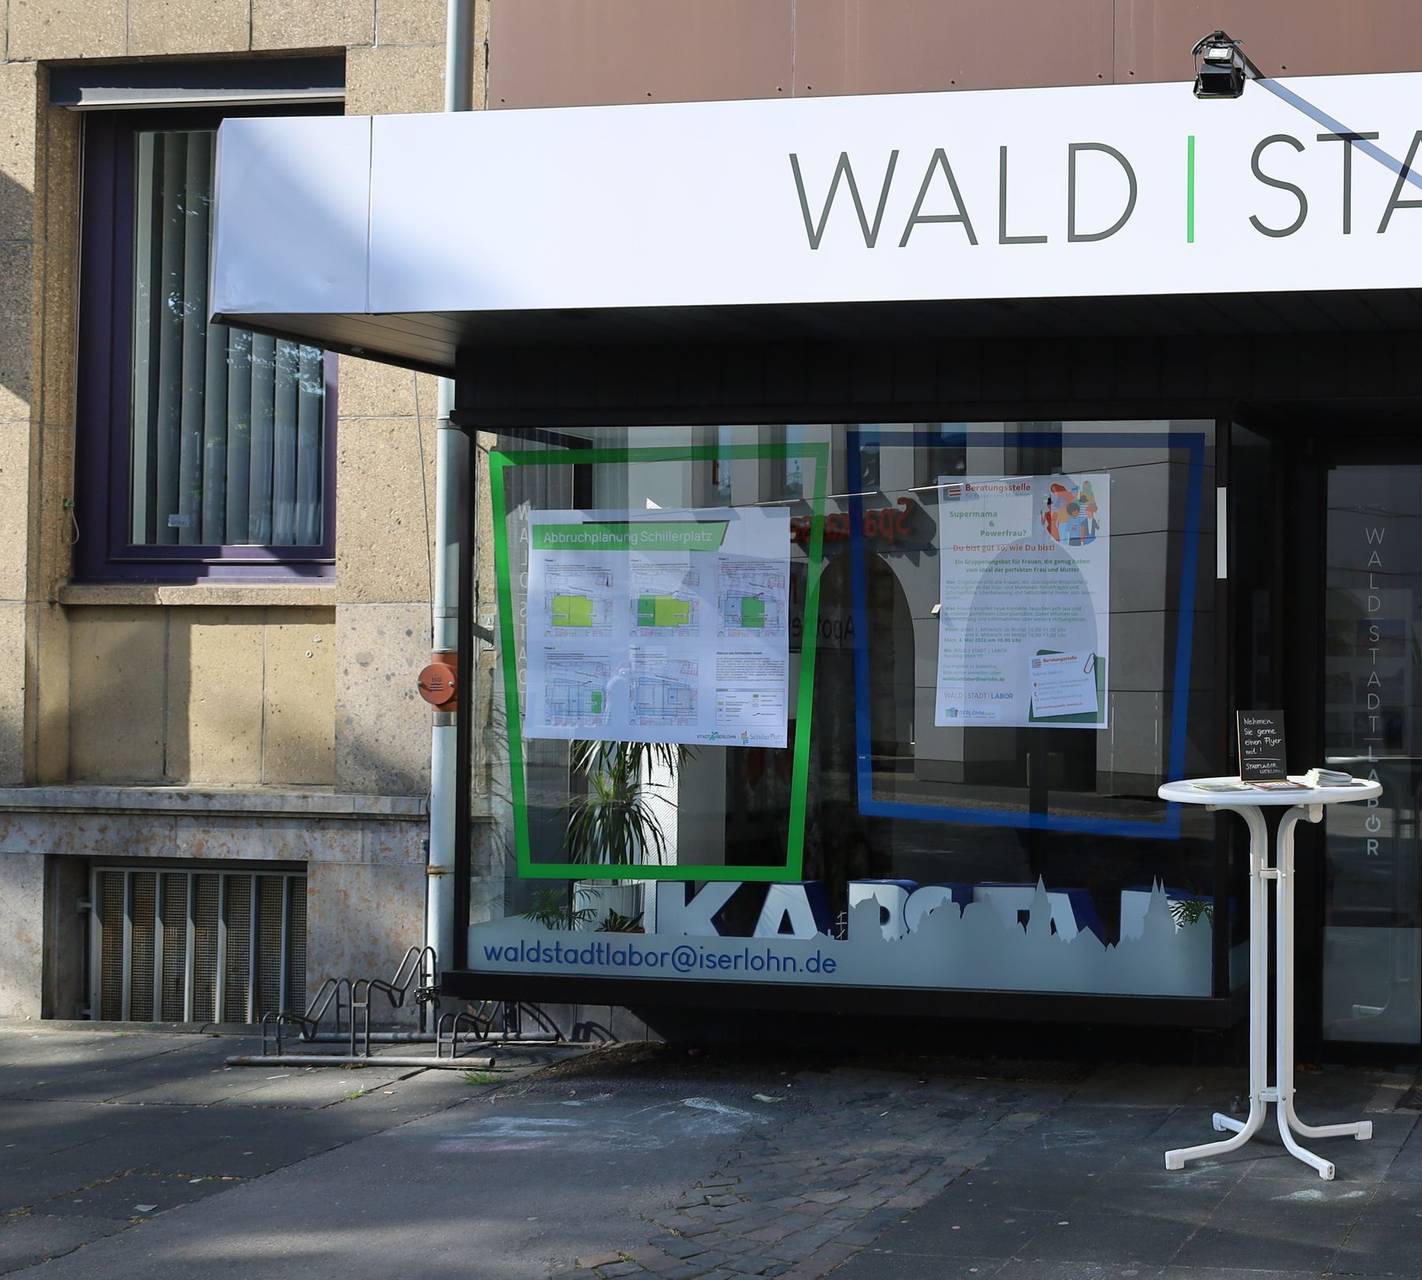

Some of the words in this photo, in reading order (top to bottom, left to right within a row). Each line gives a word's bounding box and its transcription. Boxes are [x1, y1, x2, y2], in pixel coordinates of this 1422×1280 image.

[788, 143, 1138, 251] WALD
[965, 483, 1031, 494] Beratungsstelle
[949, 511, 998, 519] Supermama
[543, 531, 638, 546] Abbruchplanung
[640, 530, 713, 545] Schillerplatz
[1364, 527, 1386, 613] WALD
[1366, 625, 1382, 733] STADT
[991, 692, 1014, 700] LABOR
[1243, 717, 1274, 725] Nehmen
[1243, 727, 1253, 736] Sie
[1257, 728, 1277, 738] gerne
[1263, 737, 1283, 747] Flyer
[482, 940, 837, 974] waldstadtlabor@iserlohn.de
